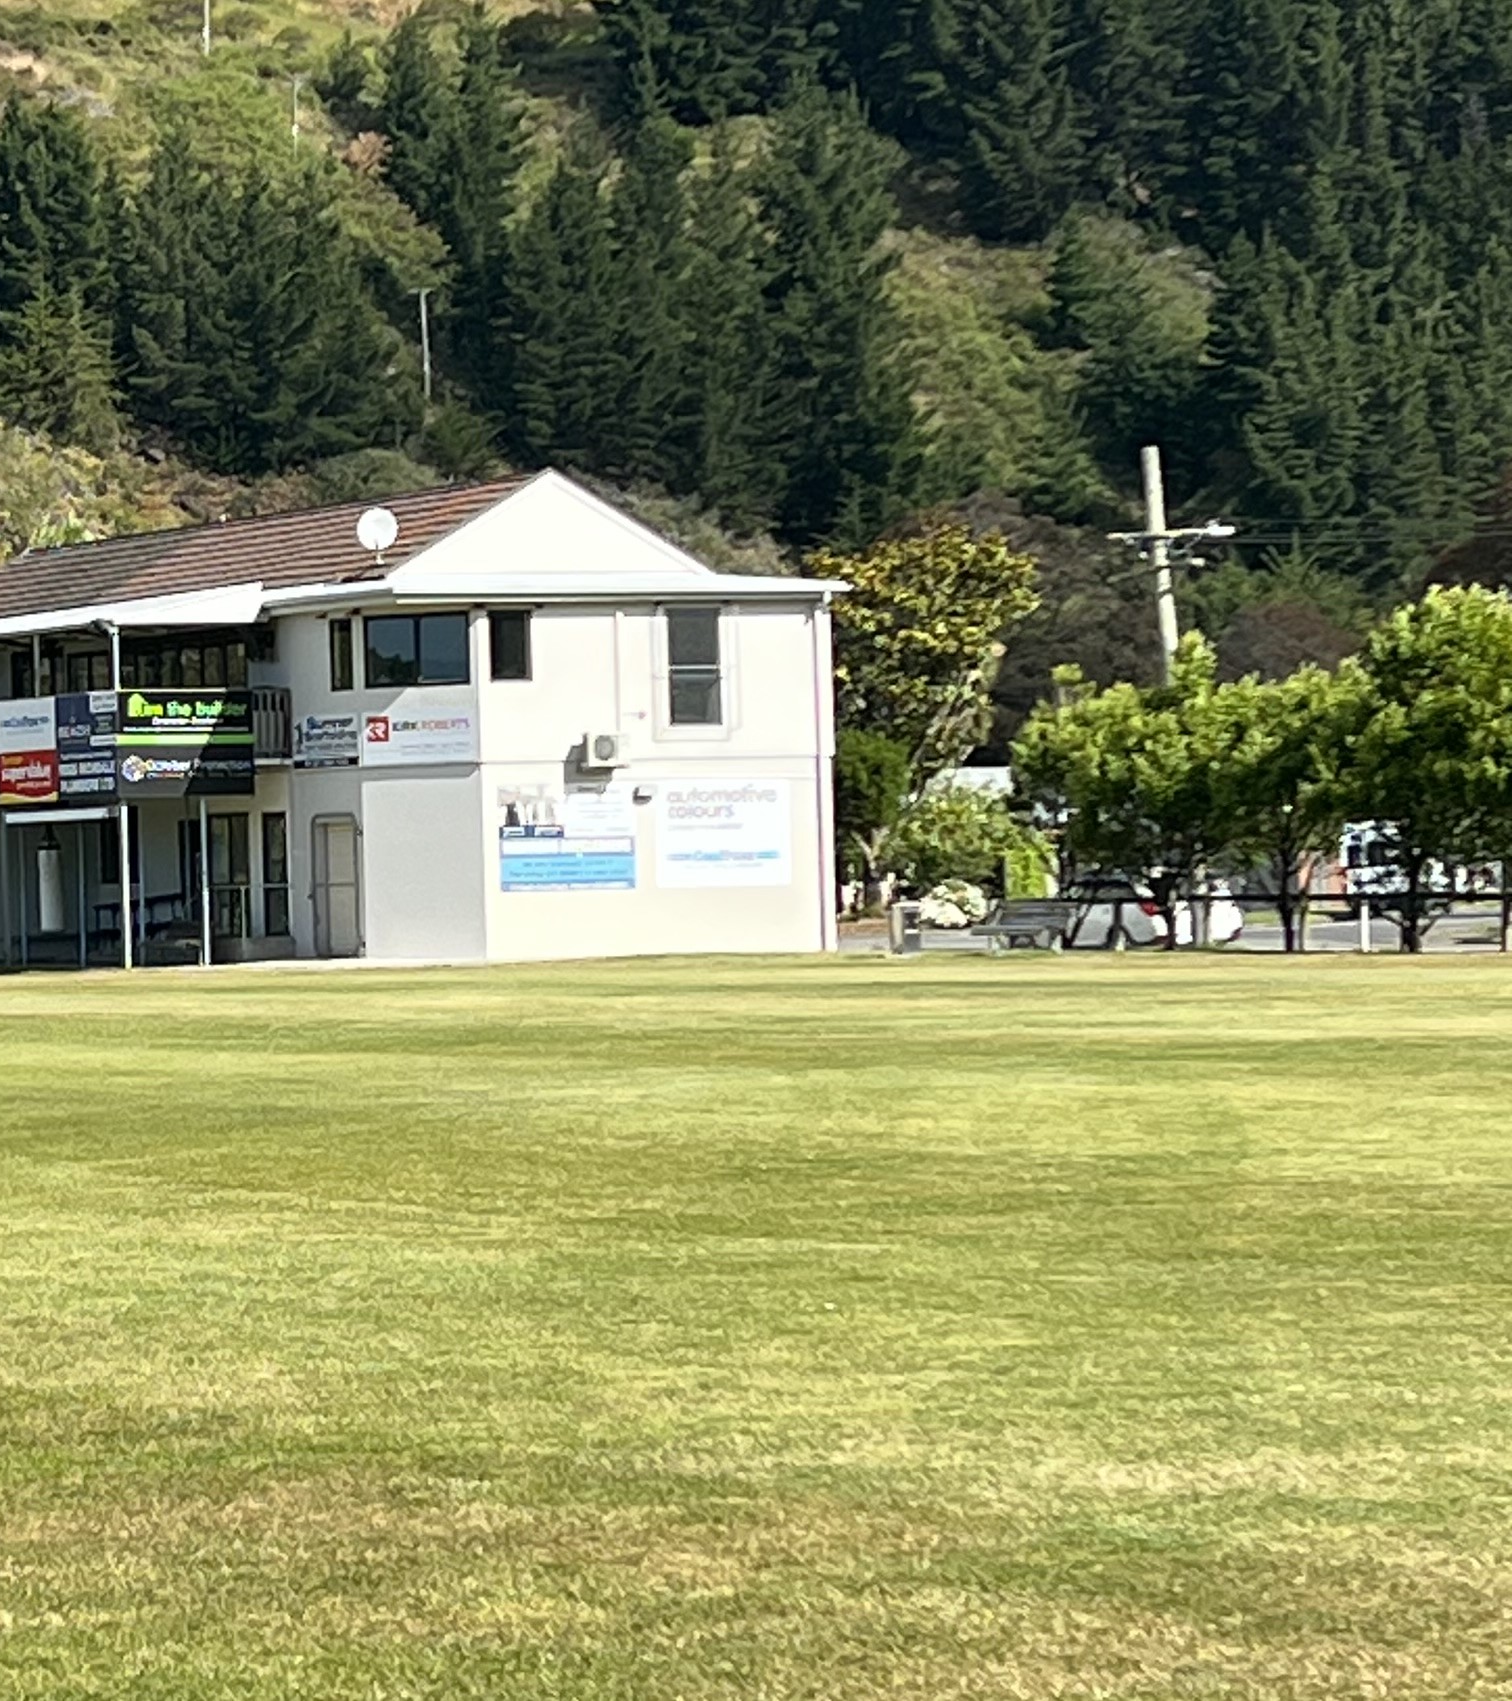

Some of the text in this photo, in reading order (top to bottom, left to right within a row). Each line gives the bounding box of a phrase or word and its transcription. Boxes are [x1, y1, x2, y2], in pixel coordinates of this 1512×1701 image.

[167, 700, 192, 717] the
[196, 700, 247, 717] builder
[422, 718, 470, 731] ROBERTS
[667, 783, 777, 803] automotive
[668, 804, 735, 819] colours
